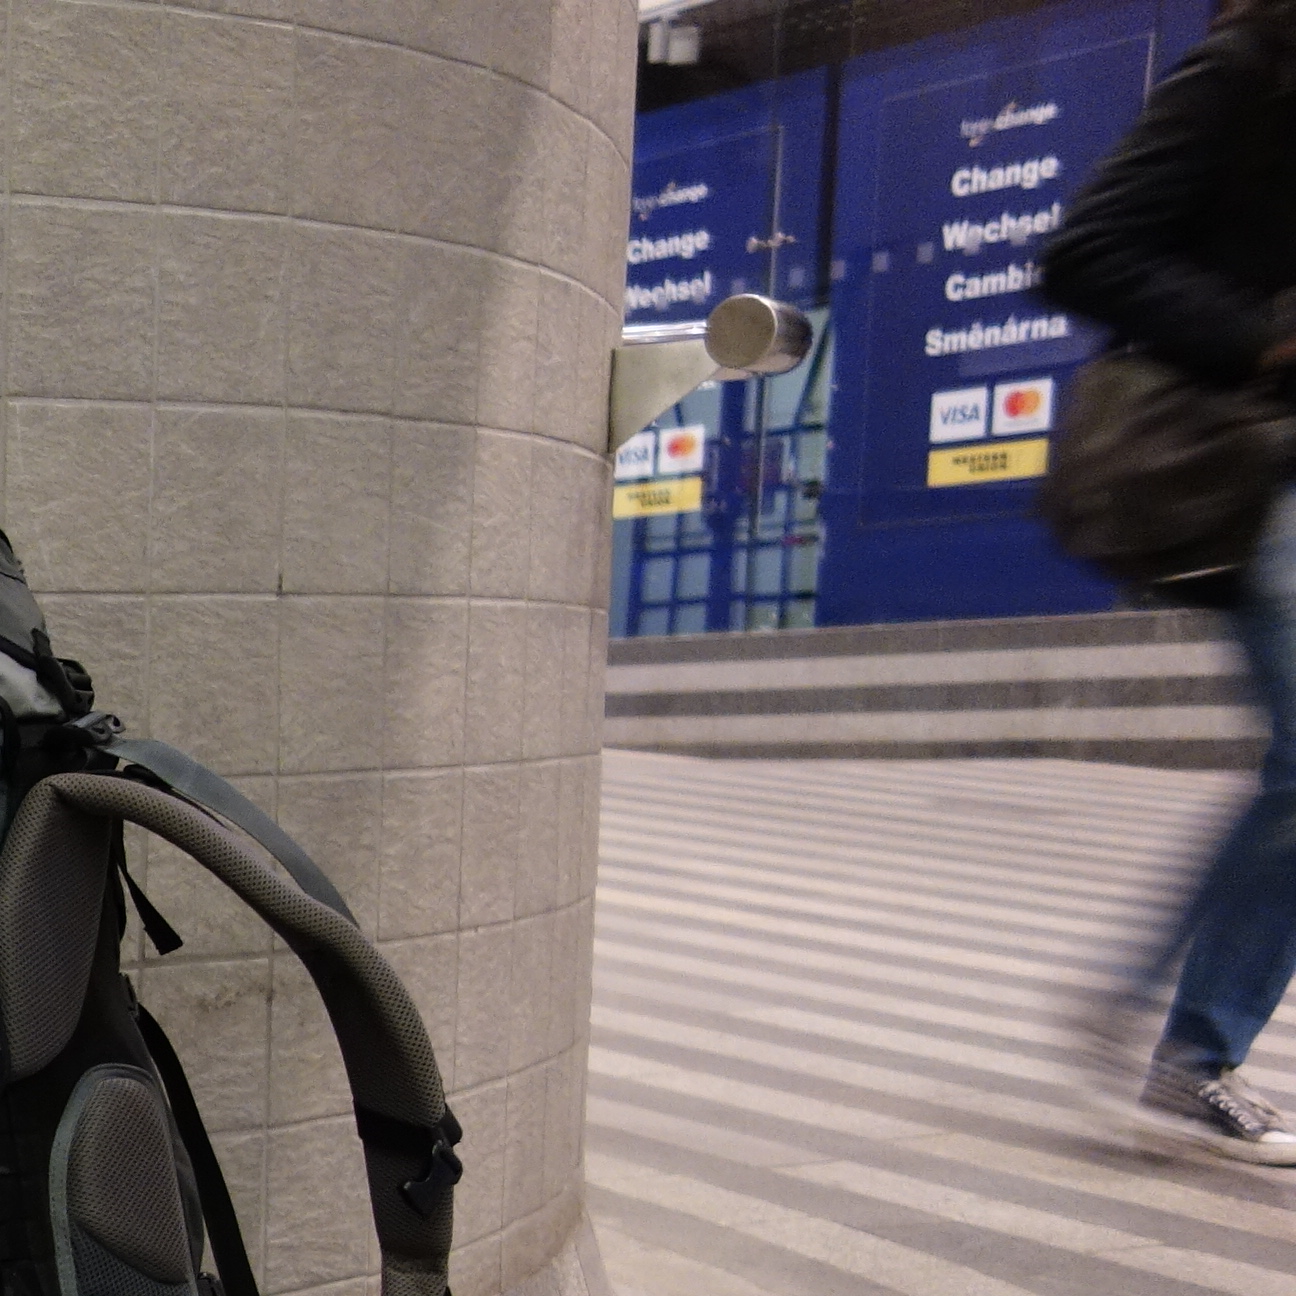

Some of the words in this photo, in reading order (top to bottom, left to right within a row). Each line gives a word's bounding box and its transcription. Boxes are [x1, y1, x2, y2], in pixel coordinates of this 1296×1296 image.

[951, 155, 1059, 196] Change
[942, 202, 1061, 251] Wechsel
[945, 261, 1042, 301] Cambi
[940, 403, 980, 425] VISA
